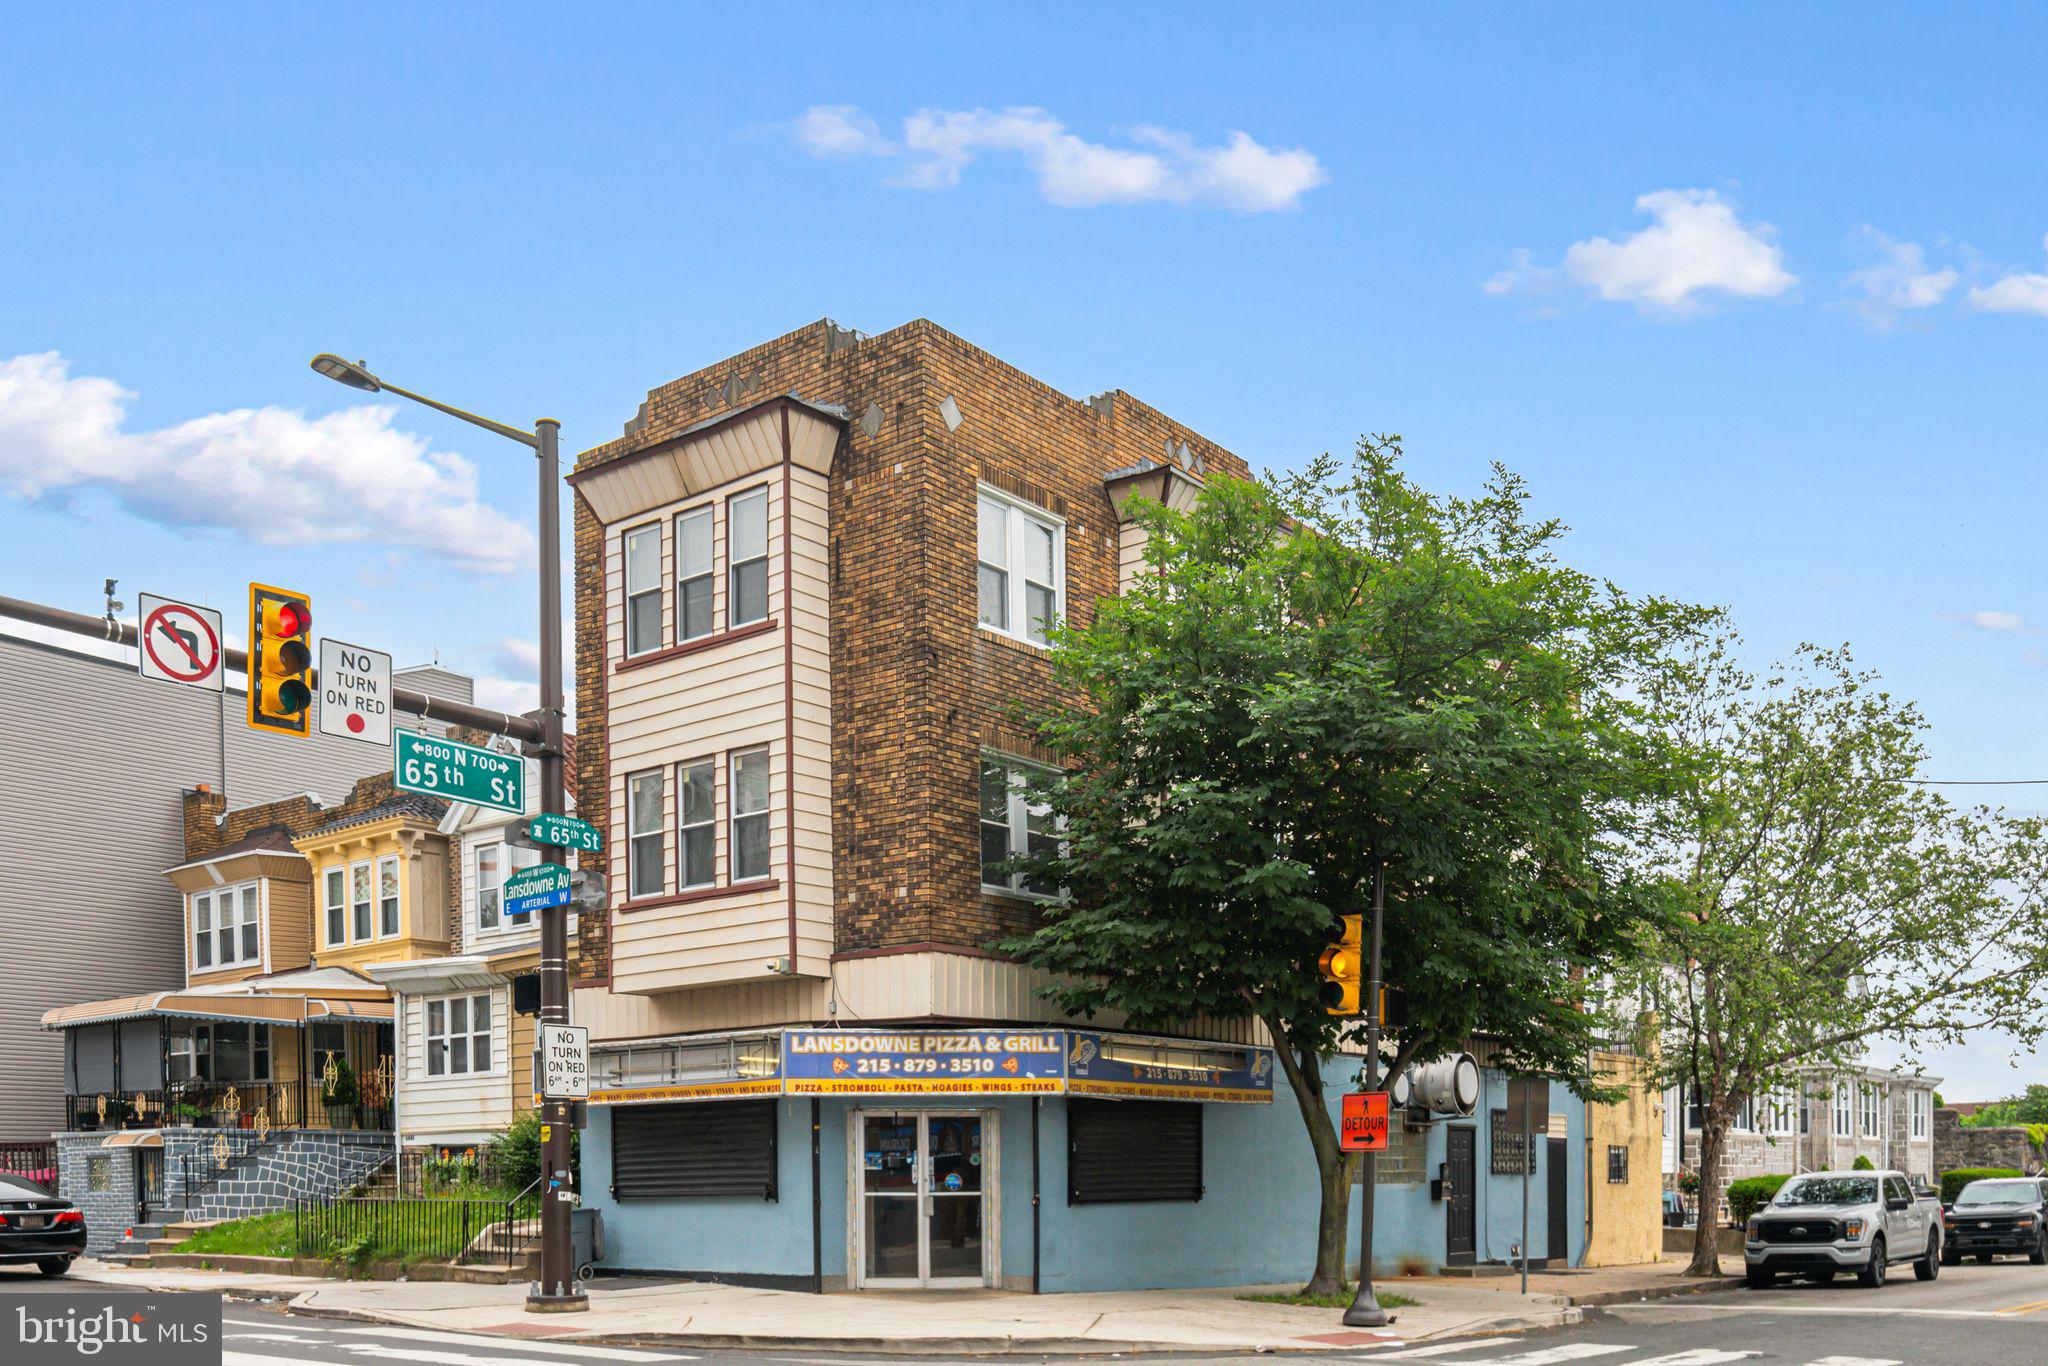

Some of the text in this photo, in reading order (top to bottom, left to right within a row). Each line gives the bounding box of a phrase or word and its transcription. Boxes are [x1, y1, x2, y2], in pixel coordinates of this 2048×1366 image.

[341, 650, 371, 673] NO
[336, 671, 377, 694] TURN
[326, 689, 385, 715] ON RED
[424, 744, 497, 772] 800 N 700
[405, 758, 516, 805] 65th St
[563, 818, 569, 827] N
[550, 826, 599, 850] 65th St
[532, 867, 539, 876] W
[504, 872, 570, 900] Lansdowne Av
[506, 891, 568, 914] E ARTERIAL W
[557, 1032, 575, 1044] NO
[791, 1035, 1060, 1054] LANSDOWNE PIZZA & GRILL
[552, 1046, 581, 1059] TURN
[548, 1061, 585, 1074] ON RED
[857, 1057, 994, 1073] 215 879 3510
[1146, 1067, 1162, 1079] 215
[1188, 1070, 1208, 1082] 3510
[739, 1085, 750, 1094] AND
[751, 1084, 766, 1094] MUCH
[767, 1083, 781, 1093] MORE
[795, 1083, 1056, 1092] PIZZA STROMBOLI PASTA HOAGIES WINGS STEAKS
[1345, 1116, 1385, 1131] DETOUR
